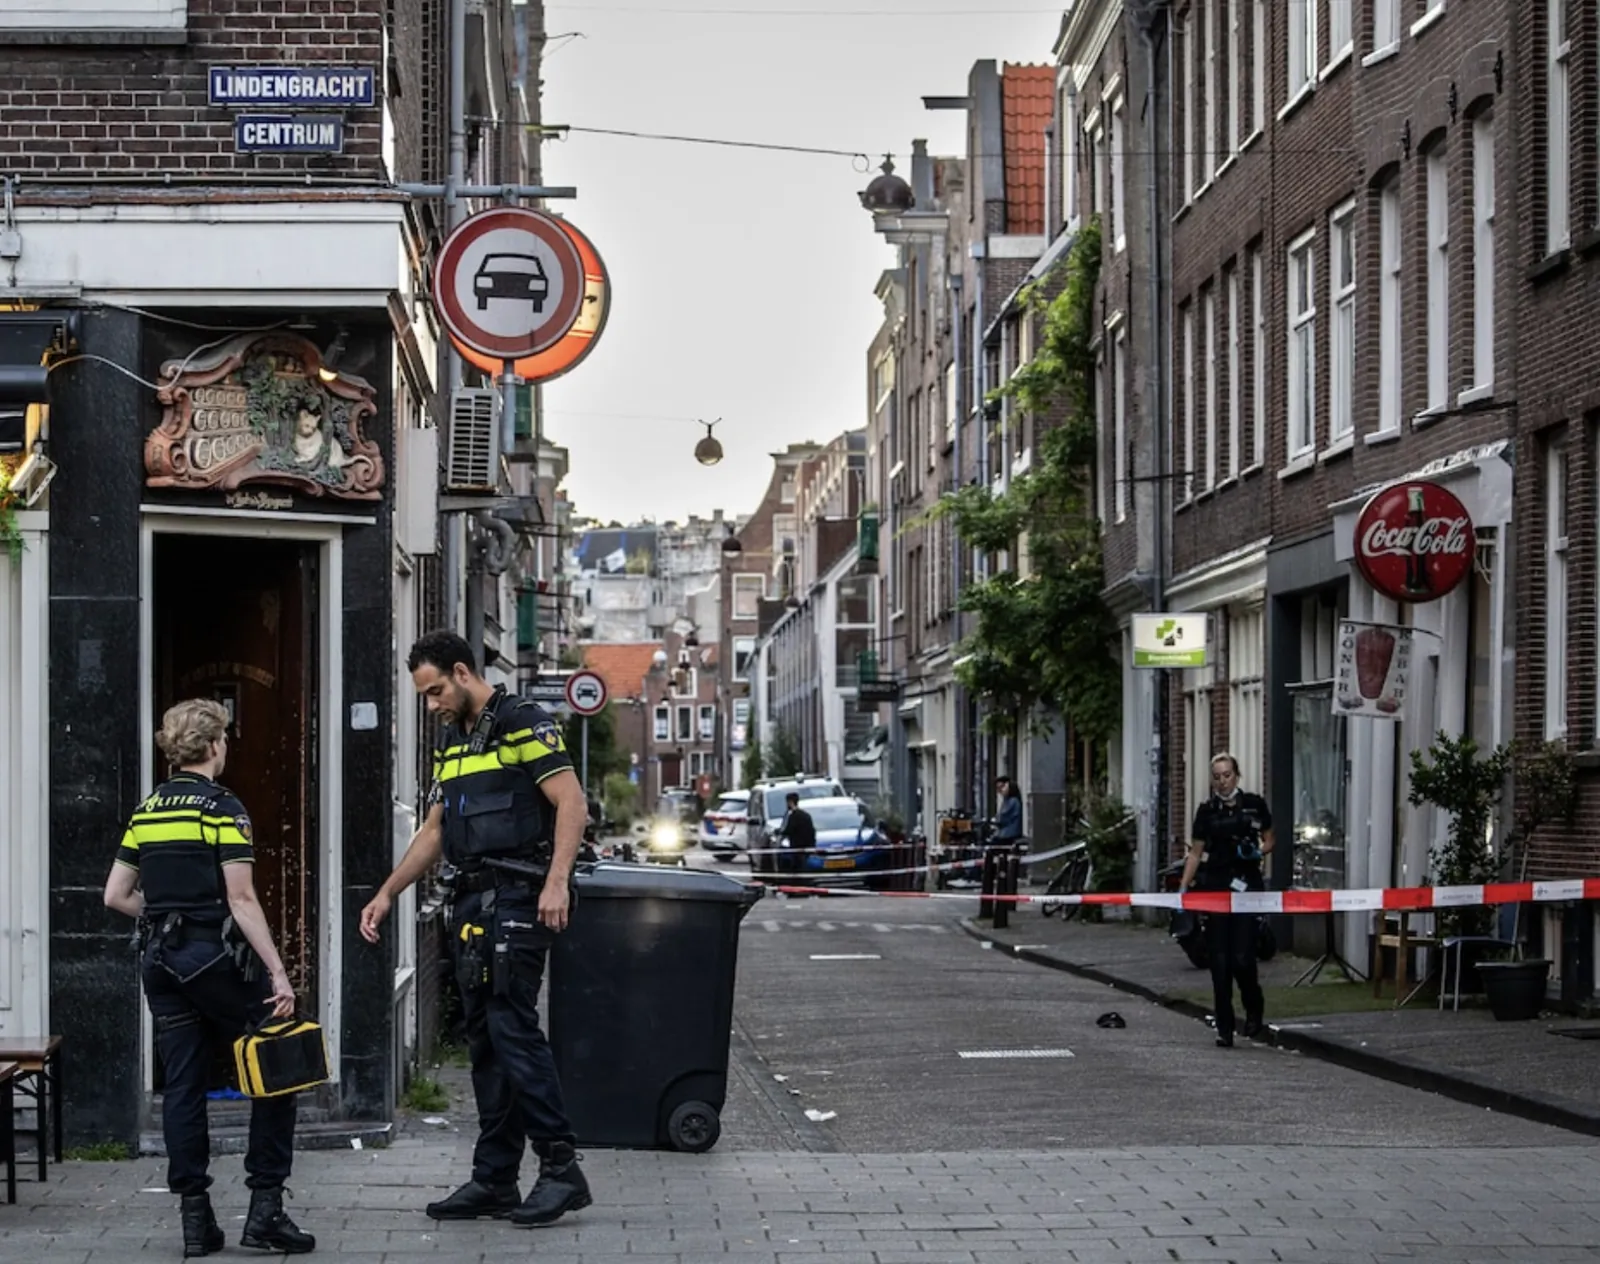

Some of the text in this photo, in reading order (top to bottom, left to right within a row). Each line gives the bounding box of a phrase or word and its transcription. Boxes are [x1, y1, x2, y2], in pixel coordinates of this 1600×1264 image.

[214, 75, 369, 98] LINDENGRACHT
[243, 122, 335, 145] CENTRUM
[1361, 516, 1469, 557] Coca-Cola
[1393, 629, 1413, 698] KEBAB
